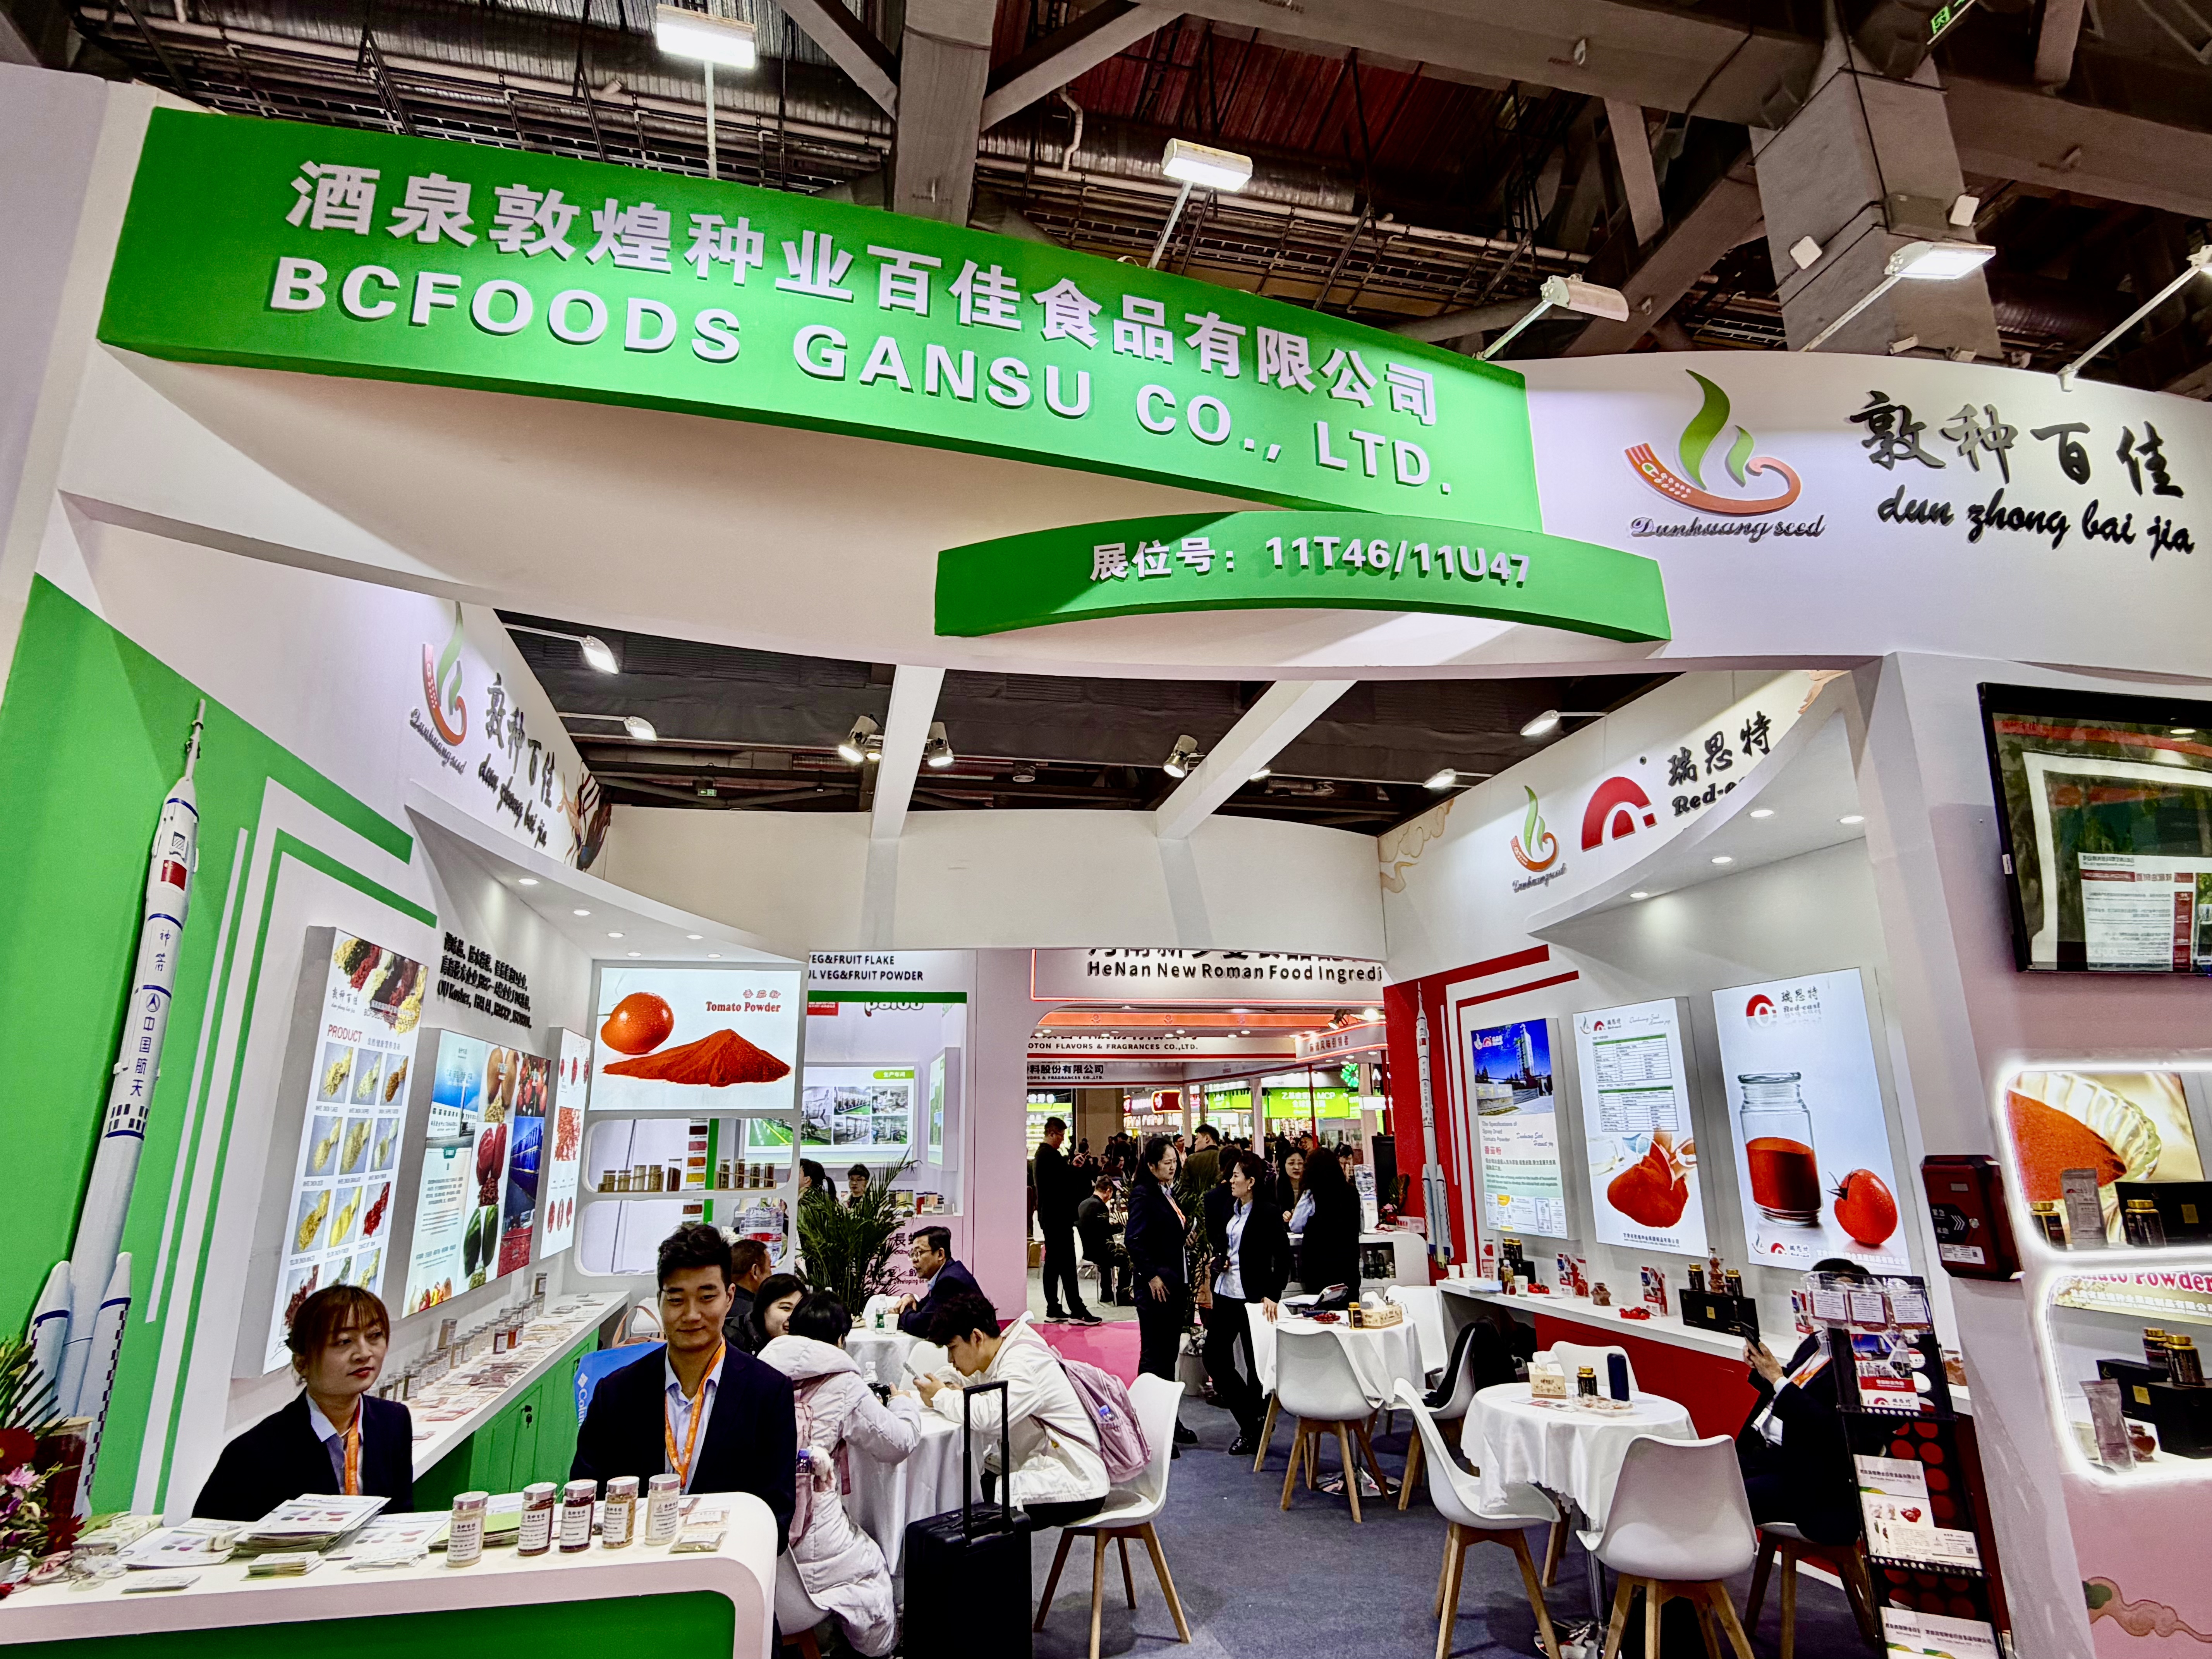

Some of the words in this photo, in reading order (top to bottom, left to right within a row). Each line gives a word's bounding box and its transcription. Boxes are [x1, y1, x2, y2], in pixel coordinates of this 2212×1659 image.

[286, 160, 1437, 426] 酒泉敦煌种业百佳食品有限公司
[270, 256, 741, 362] BCFOODS
[792, 325, 1091, 419] GANSU
[1135, 384, 1282, 462] CO.,
[1315, 420, 1452, 493] LTD.
[1850, 390, 2185, 499] 敦种百佳
[1878, 484, 1953, 526] dun
[1966, 487, 2071, 550] zhong
[2081, 499, 2136, 544] bai
[2147, 513, 2196, 560] jia
[1090, 541, 1237, 582] 展位号：
[1265, 535, 1530, 586] 11T46/11U47
[1671, 776, 1746, 817] Red-e
[809, 954, 862, 964] EG&FRUIT
[865, 955, 895, 965] FLAKE
[820, 970, 878, 980] VEG&FRUIT
[880, 970, 924, 981] POWDER
[1087, 961, 1151, 977] HeNan
[1157, 962, 1196, 978] New
[1202, 963, 1264, 979] Roman
[1269, 965, 1313, 980] Food
[1319, 966, 1382, 984] Ingredi
[706, 1001, 742, 1012] Tomato
[744, 1002, 781, 1013] Powder
[327, 1024, 363, 1043] PRODUCT
[130, 1016, 156, 1098] 中国航天
[1027, 1065, 1104, 1074] 料股份有限公司
